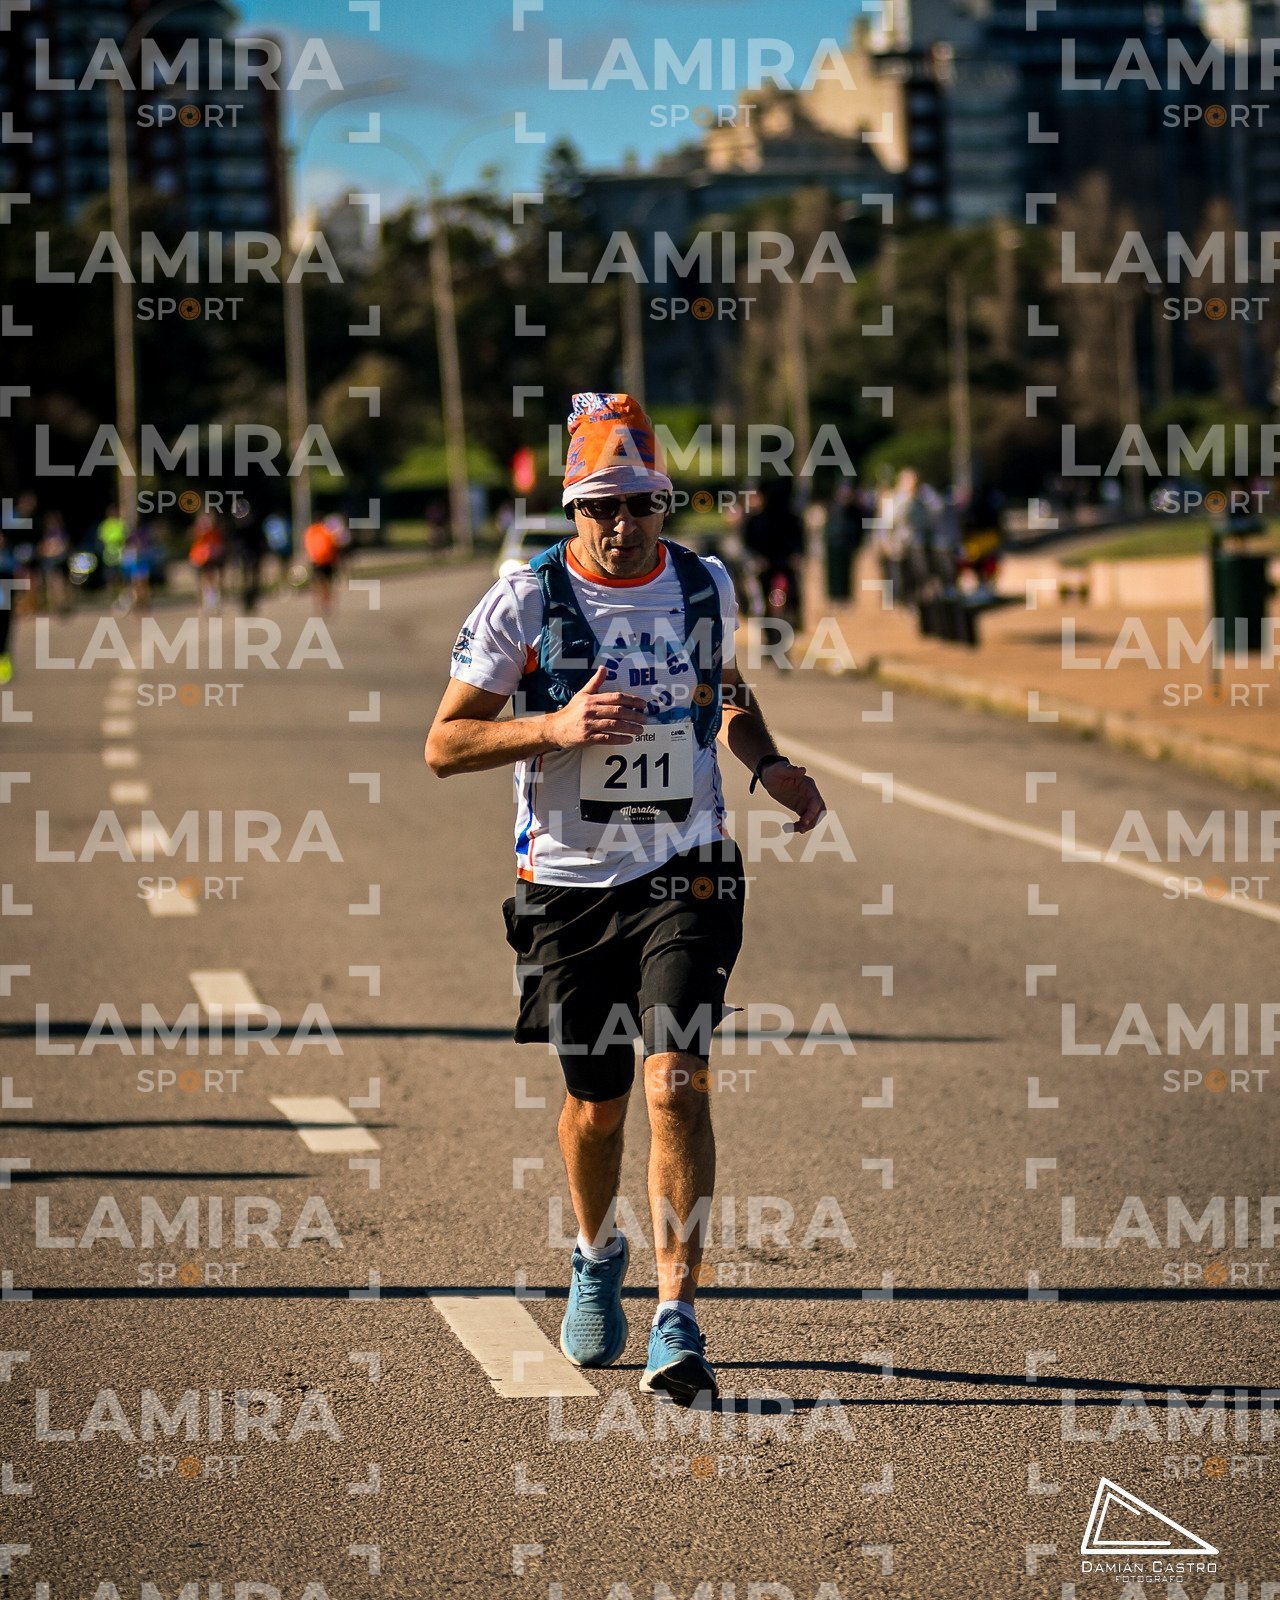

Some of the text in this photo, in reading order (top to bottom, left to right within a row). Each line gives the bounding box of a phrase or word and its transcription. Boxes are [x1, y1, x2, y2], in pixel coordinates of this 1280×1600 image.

[629, 667, 658, 686] DEL
[635, 733, 656, 742] antel
[604, 753, 670, 789] 211
[620, 806, 661, 816] Maratón
